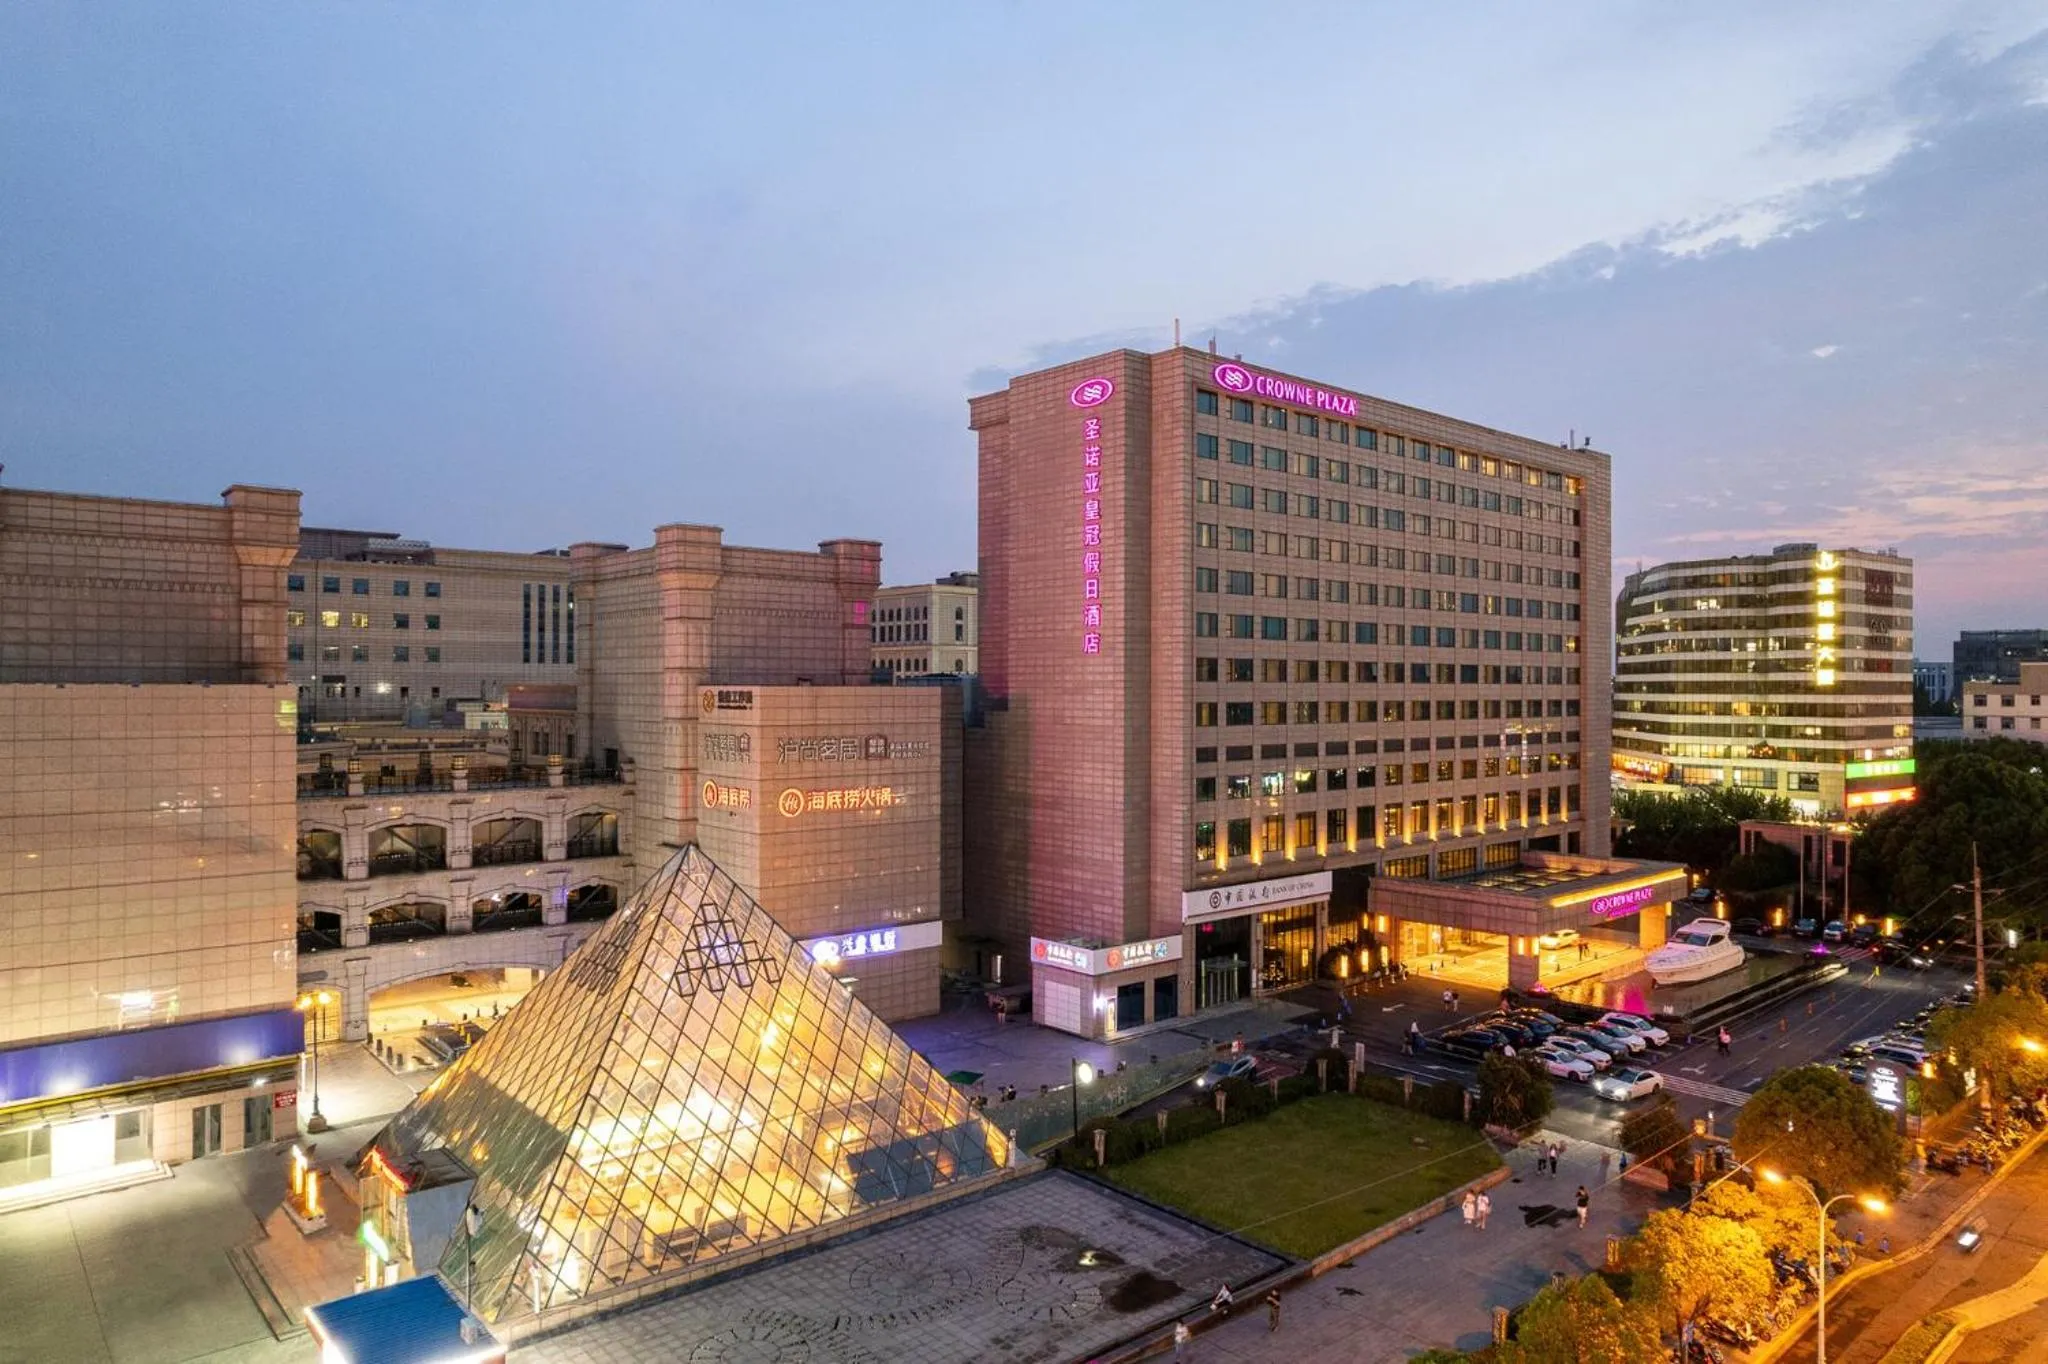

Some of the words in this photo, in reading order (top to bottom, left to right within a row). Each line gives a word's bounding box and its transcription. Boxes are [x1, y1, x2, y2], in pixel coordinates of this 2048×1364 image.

[1256, 376, 1313, 405] CROWNE
[1317, 390, 1356, 416] PLAZA
[1083, 418, 1101, 654] 圣诺亚皇冠假日酒店
[776, 736, 859, 765] 沪尚茗居
[807, 786, 892, 811] 海底捞火锅
